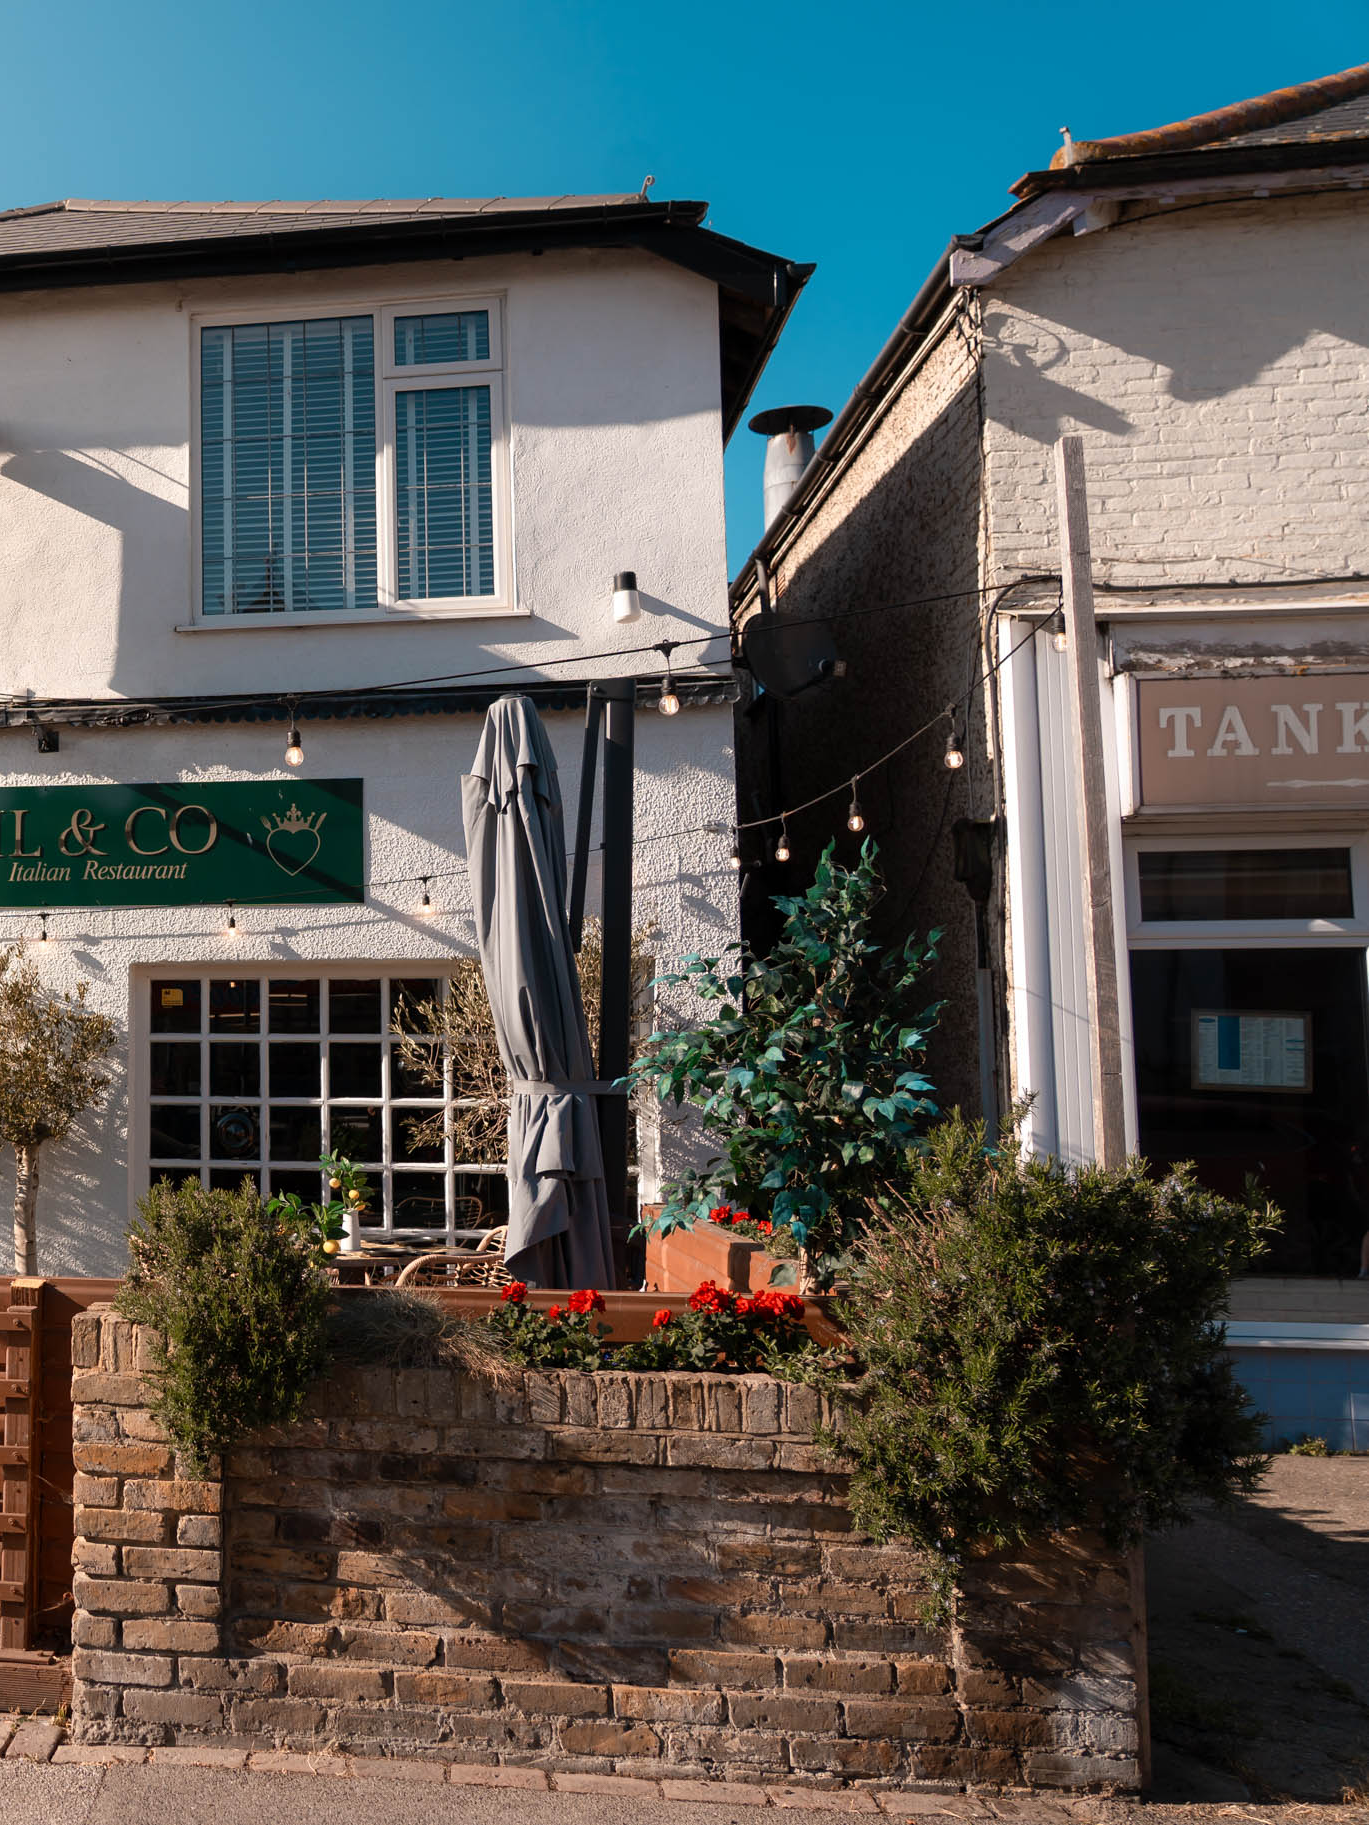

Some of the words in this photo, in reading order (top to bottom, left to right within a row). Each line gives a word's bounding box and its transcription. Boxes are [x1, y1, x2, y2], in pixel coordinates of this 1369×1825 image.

[58, 808, 110, 857] &
[125, 804, 218, 856] CO
[8, 860, 72, 882] Italian
[82, 859, 189, 881] Restaurant
